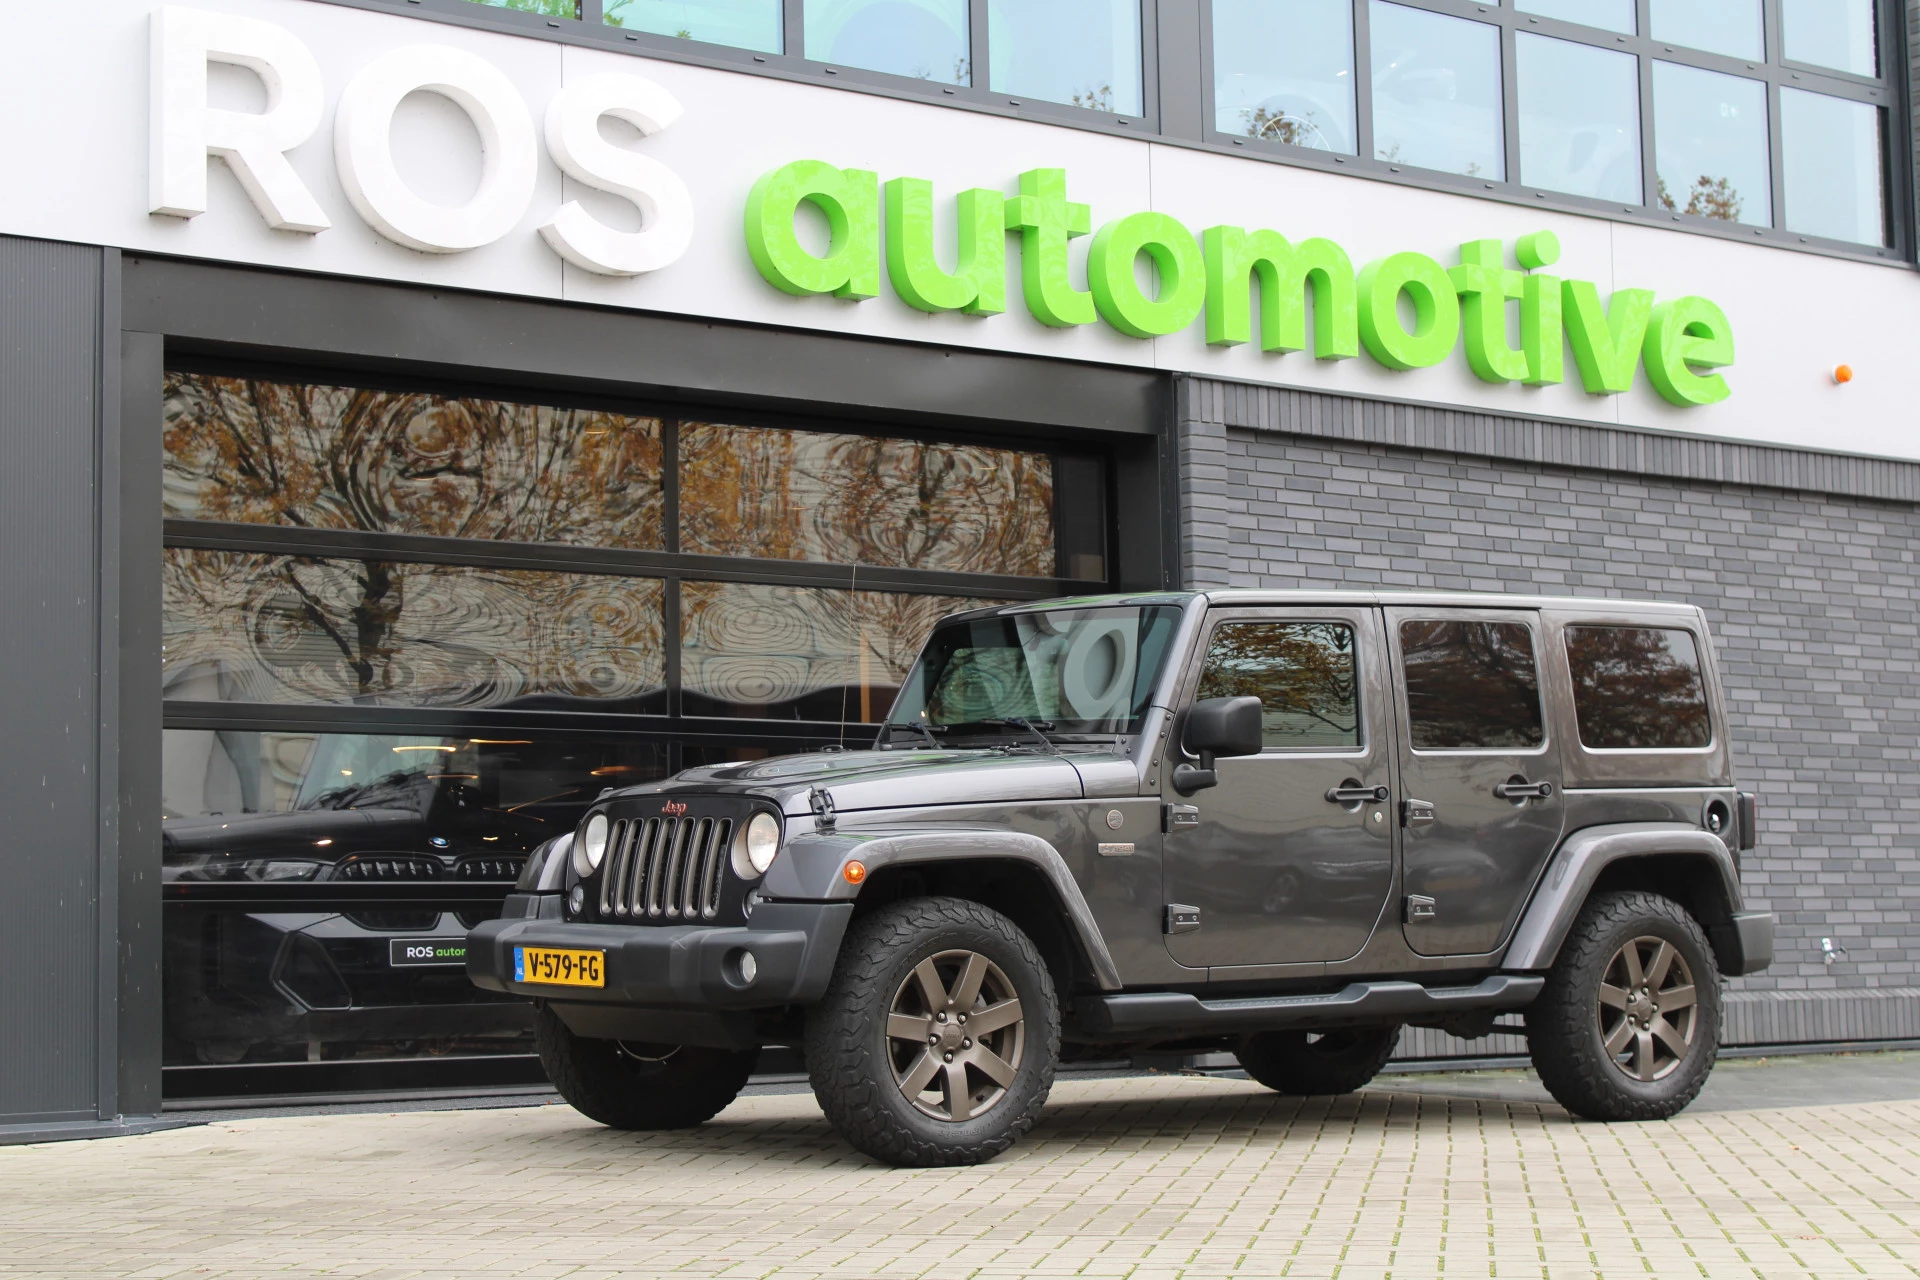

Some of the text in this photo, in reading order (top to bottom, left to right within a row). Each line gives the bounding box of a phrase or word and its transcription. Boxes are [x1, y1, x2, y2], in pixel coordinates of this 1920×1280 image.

[149, 6, 1734, 407] ROS automotive
[406, 946, 434, 958] ROS
[528, 952, 599, 981] V-579-FG
